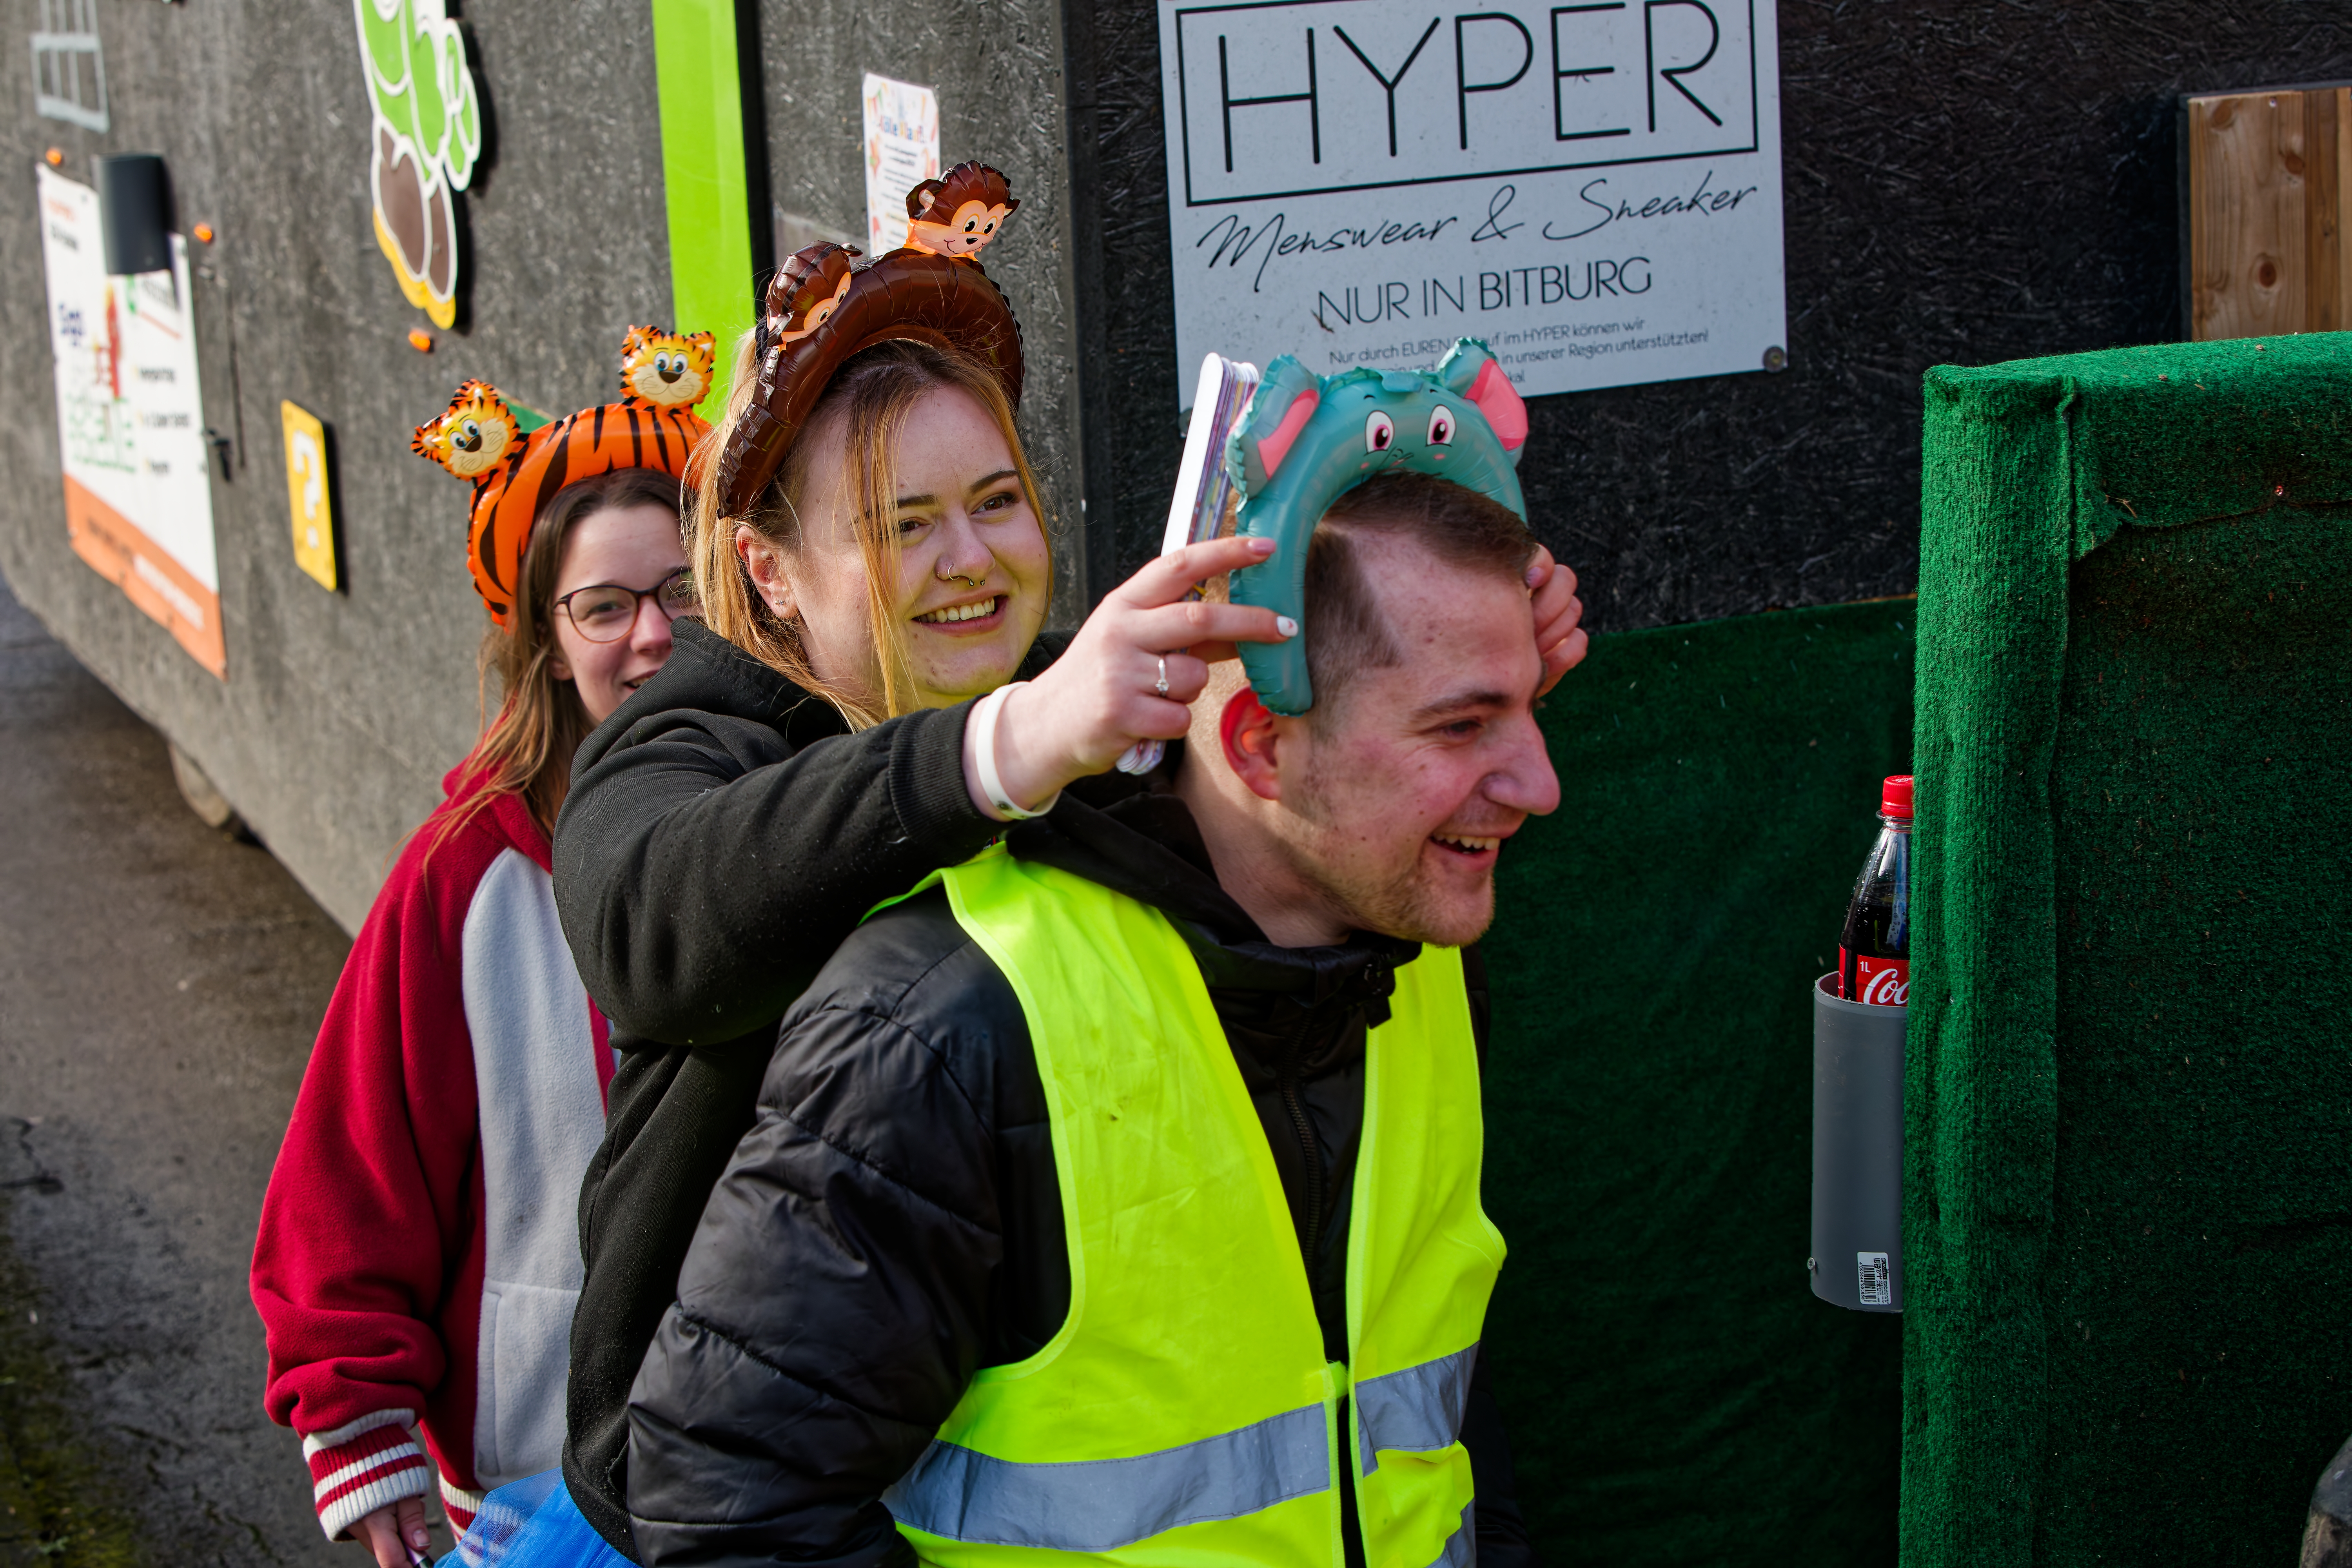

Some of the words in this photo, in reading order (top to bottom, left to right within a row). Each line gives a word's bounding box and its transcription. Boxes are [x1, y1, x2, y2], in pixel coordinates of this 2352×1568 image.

[1218, 0, 1722, 172] HYPER
[1196, 213, 1457, 292] Menswear
[1471, 184, 1525, 242] &
[1542, 170, 1757, 240] Sneaker
[1318, 281, 1410, 325] NUR
[1423, 275, 1464, 316] IN
[1479, 256, 1652, 310] BITBURG
[1502, 351, 1514, 365] in
[1516, 347, 1565, 363] unserer
[1569, 340, 1613, 359] Region
[1615, 328, 1710, 352] unterstützten!
[1504, 331, 1521, 344] im
[1523, 324, 1570, 342] HYPER
[1573, 321, 1620, 337] können
[1622, 316, 1646, 332] wir
[1329, 350, 1355, 365] Nur
[1358, 344, 1399, 362] durch
[1401, 338, 1450, 358] EUREN
[1860, 961, 1871, 973] 1L
